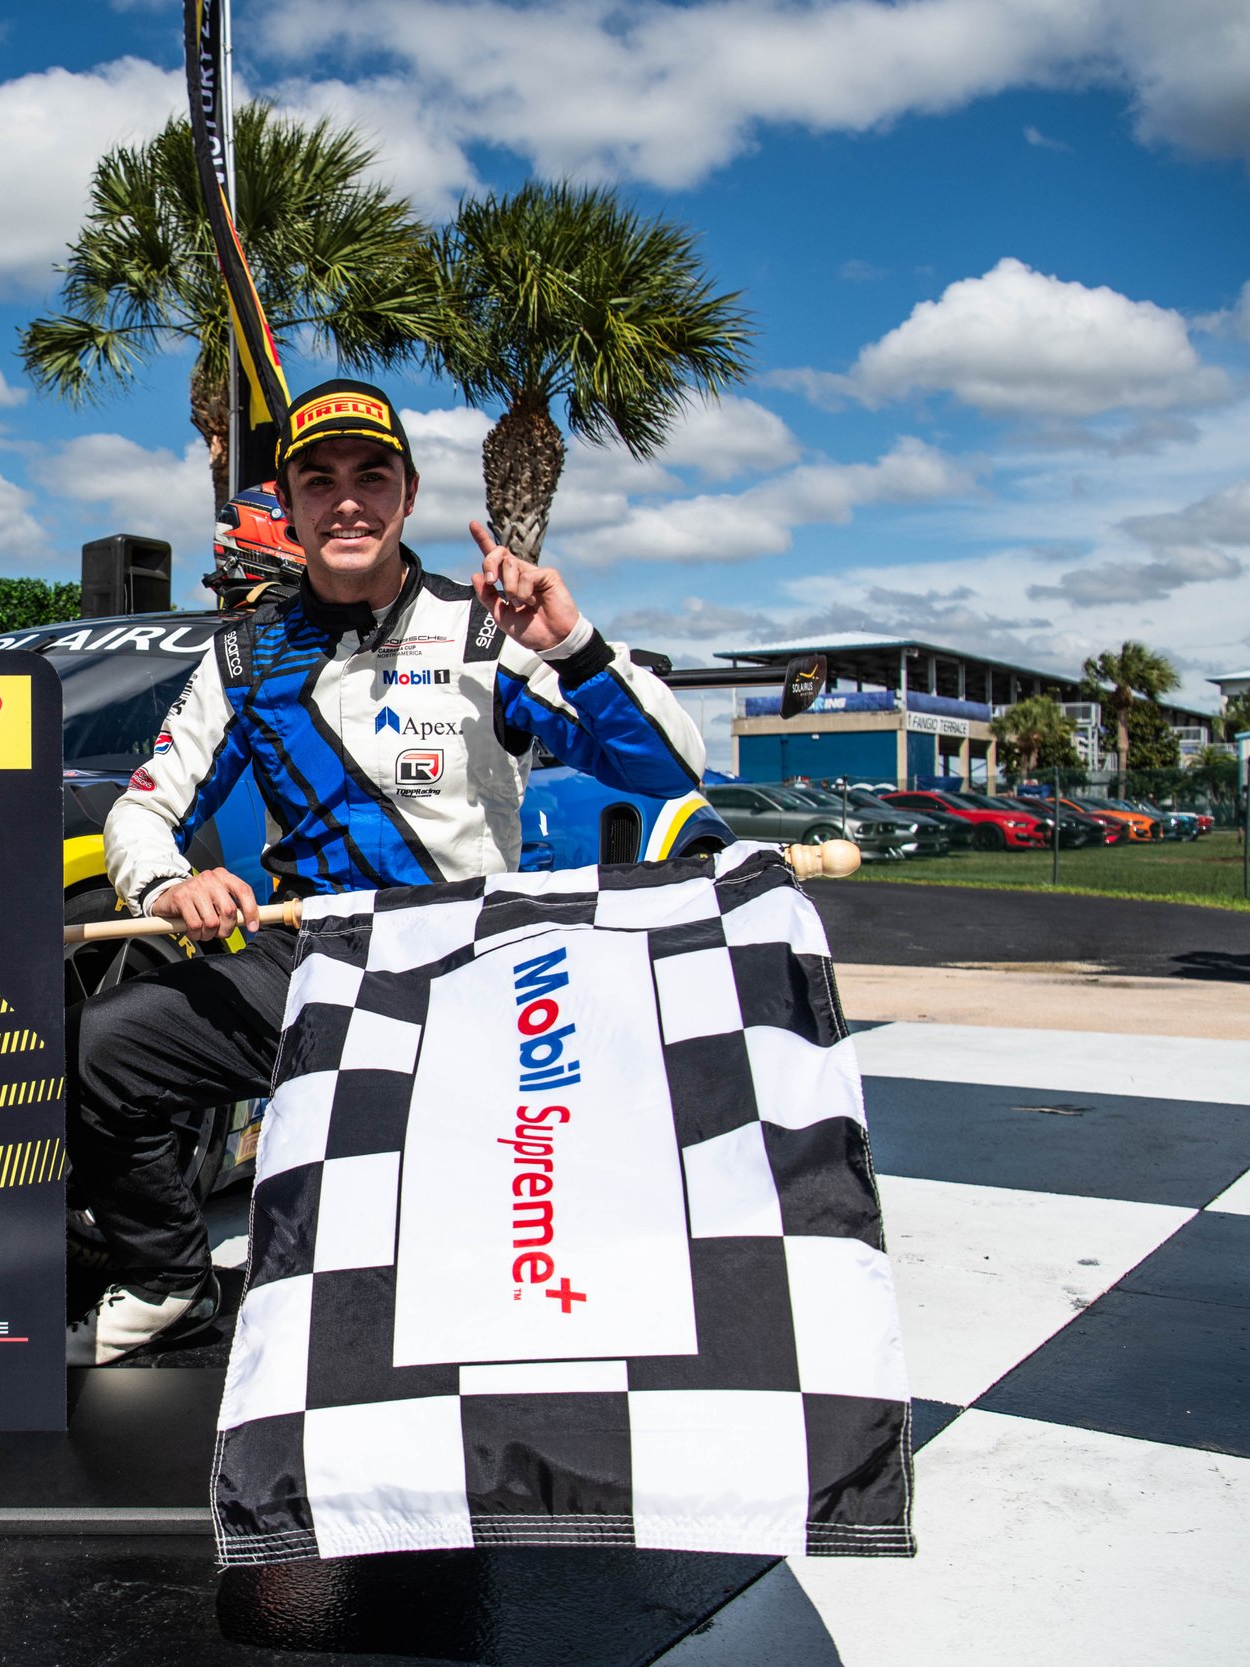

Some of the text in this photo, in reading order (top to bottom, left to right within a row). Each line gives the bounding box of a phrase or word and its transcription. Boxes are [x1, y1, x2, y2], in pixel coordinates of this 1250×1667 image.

[296, 396, 384, 430] PIRELLI
[225, 631, 243, 677] sparco
[382, 670, 448, 685] Mobil 1
[792, 682, 814, 694] SOLAIRUS
[812, 698, 847, 711] RING
[940, 719, 968, 735] TERRACE
[513, 946, 582, 1092] Mobil
